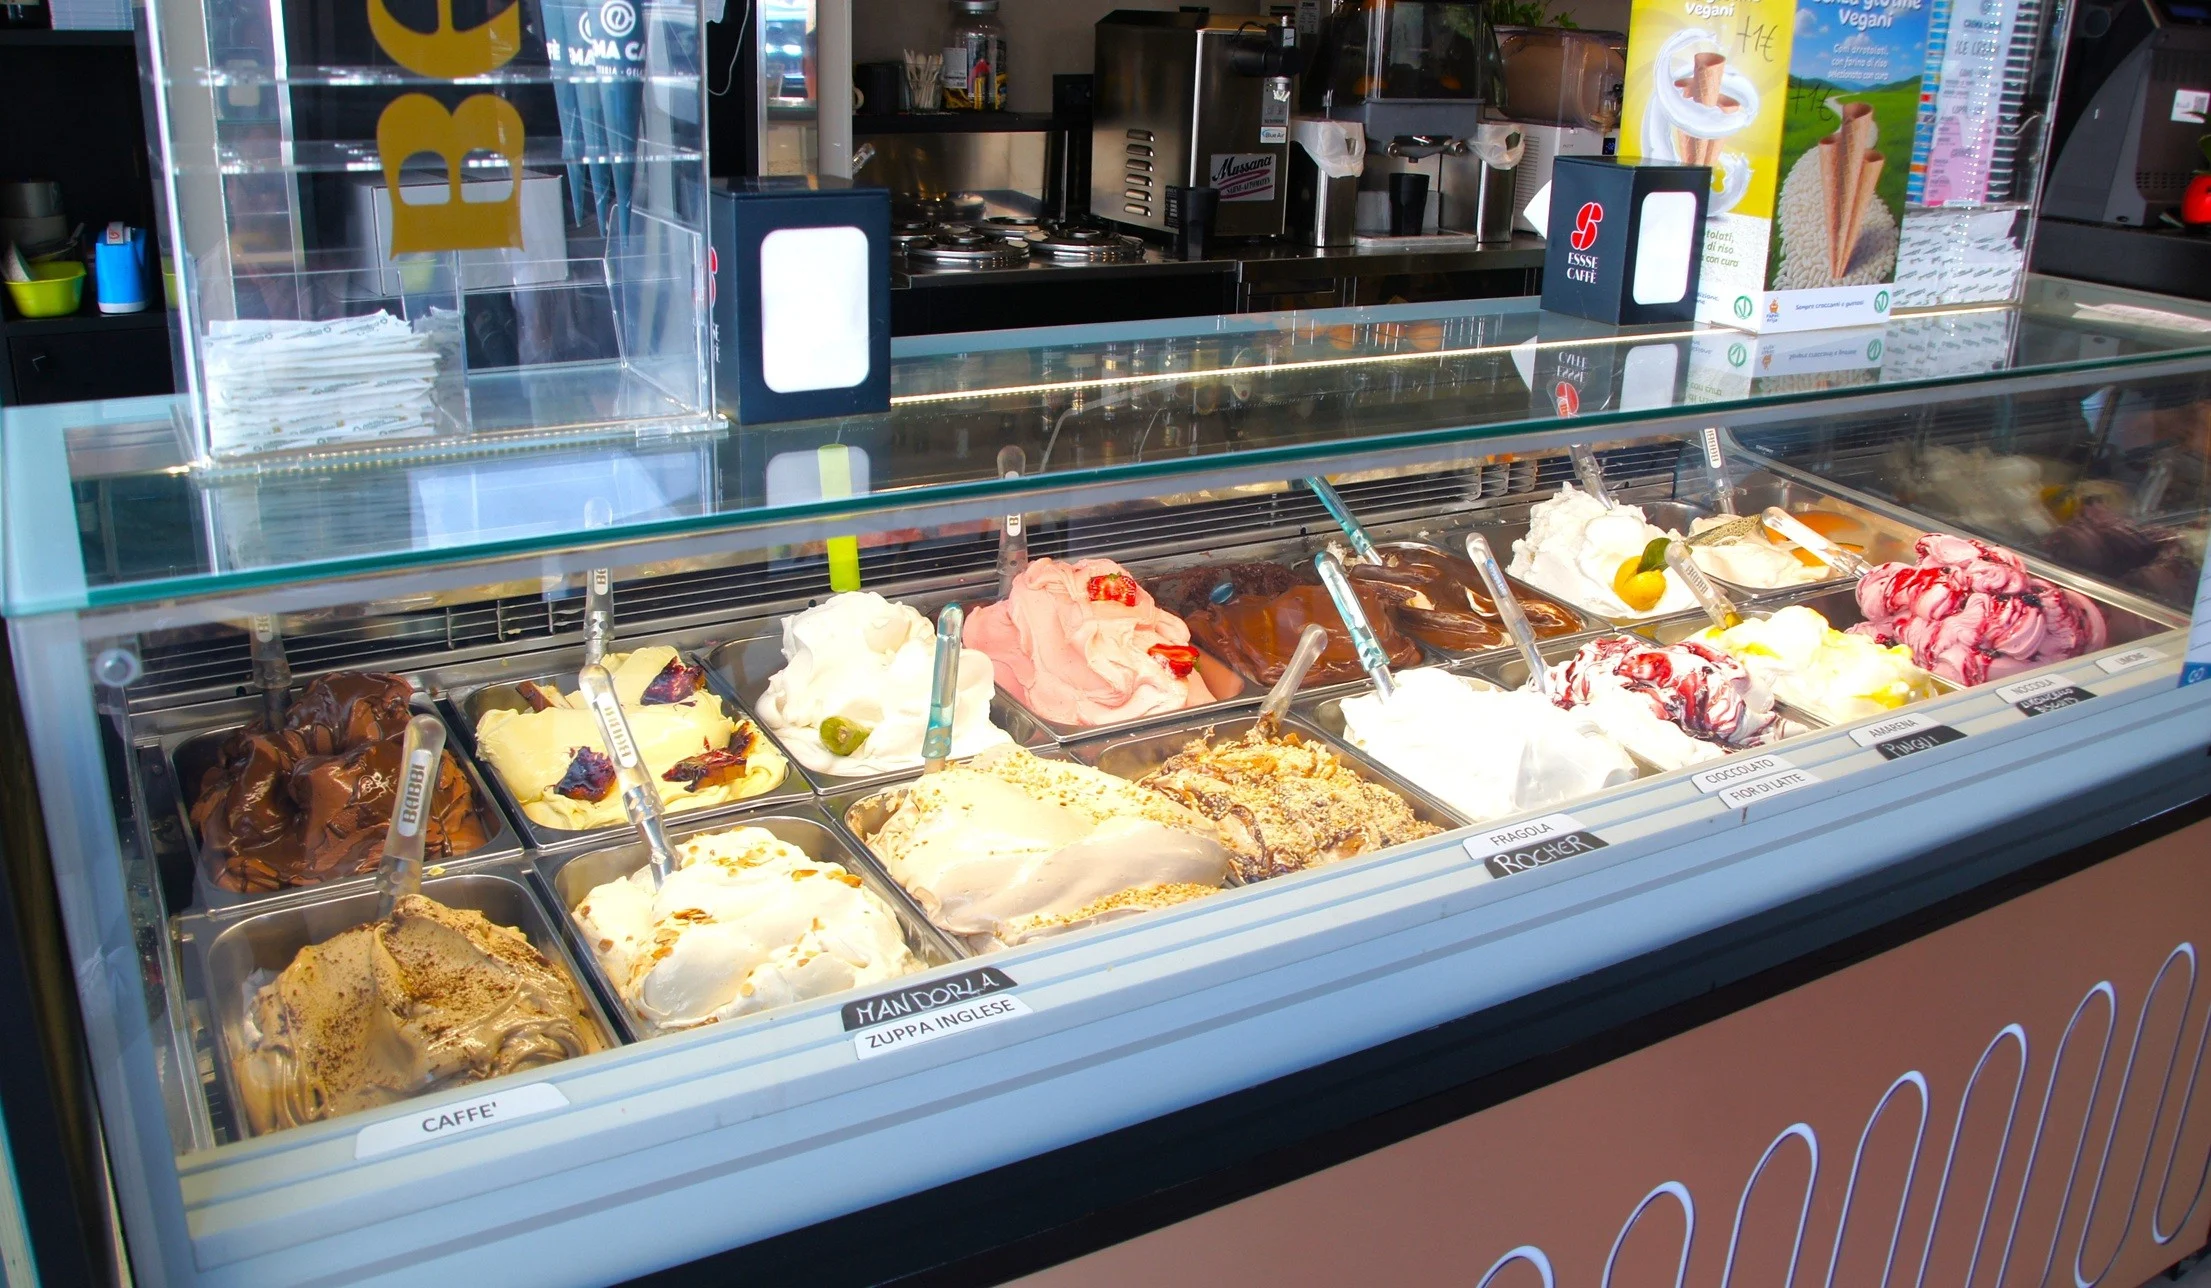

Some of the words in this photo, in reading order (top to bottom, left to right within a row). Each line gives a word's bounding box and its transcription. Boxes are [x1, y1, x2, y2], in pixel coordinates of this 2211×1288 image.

[1839, 9, 1893, 31] Vegani
[1212, 156, 1272, 181] Mussana
[1568, 252, 1598, 269] ESSSE
[1566, 267, 1597, 284] CAFFÈ
[1868, 719, 1919, 739] AMARENA
[1705, 759, 1775, 784] CIOCCOLATO
[401, 762, 426, 825] BABBI
[1730, 787, 1760, 801] FIOR
[1758, 783, 1773, 794] DI
[1770, 773, 1806, 789] LATTE
[1490, 823, 1554, 846] FRAGOLA
[1493, 835, 1595, 874] ROCHER
[856, 972, 1000, 1025] MANDORLA
[865, 1021, 935, 1049] ZUPPA
[935, 999, 1016, 1029] INGLESE
[422, 1101, 497, 1133] CAFFE'
